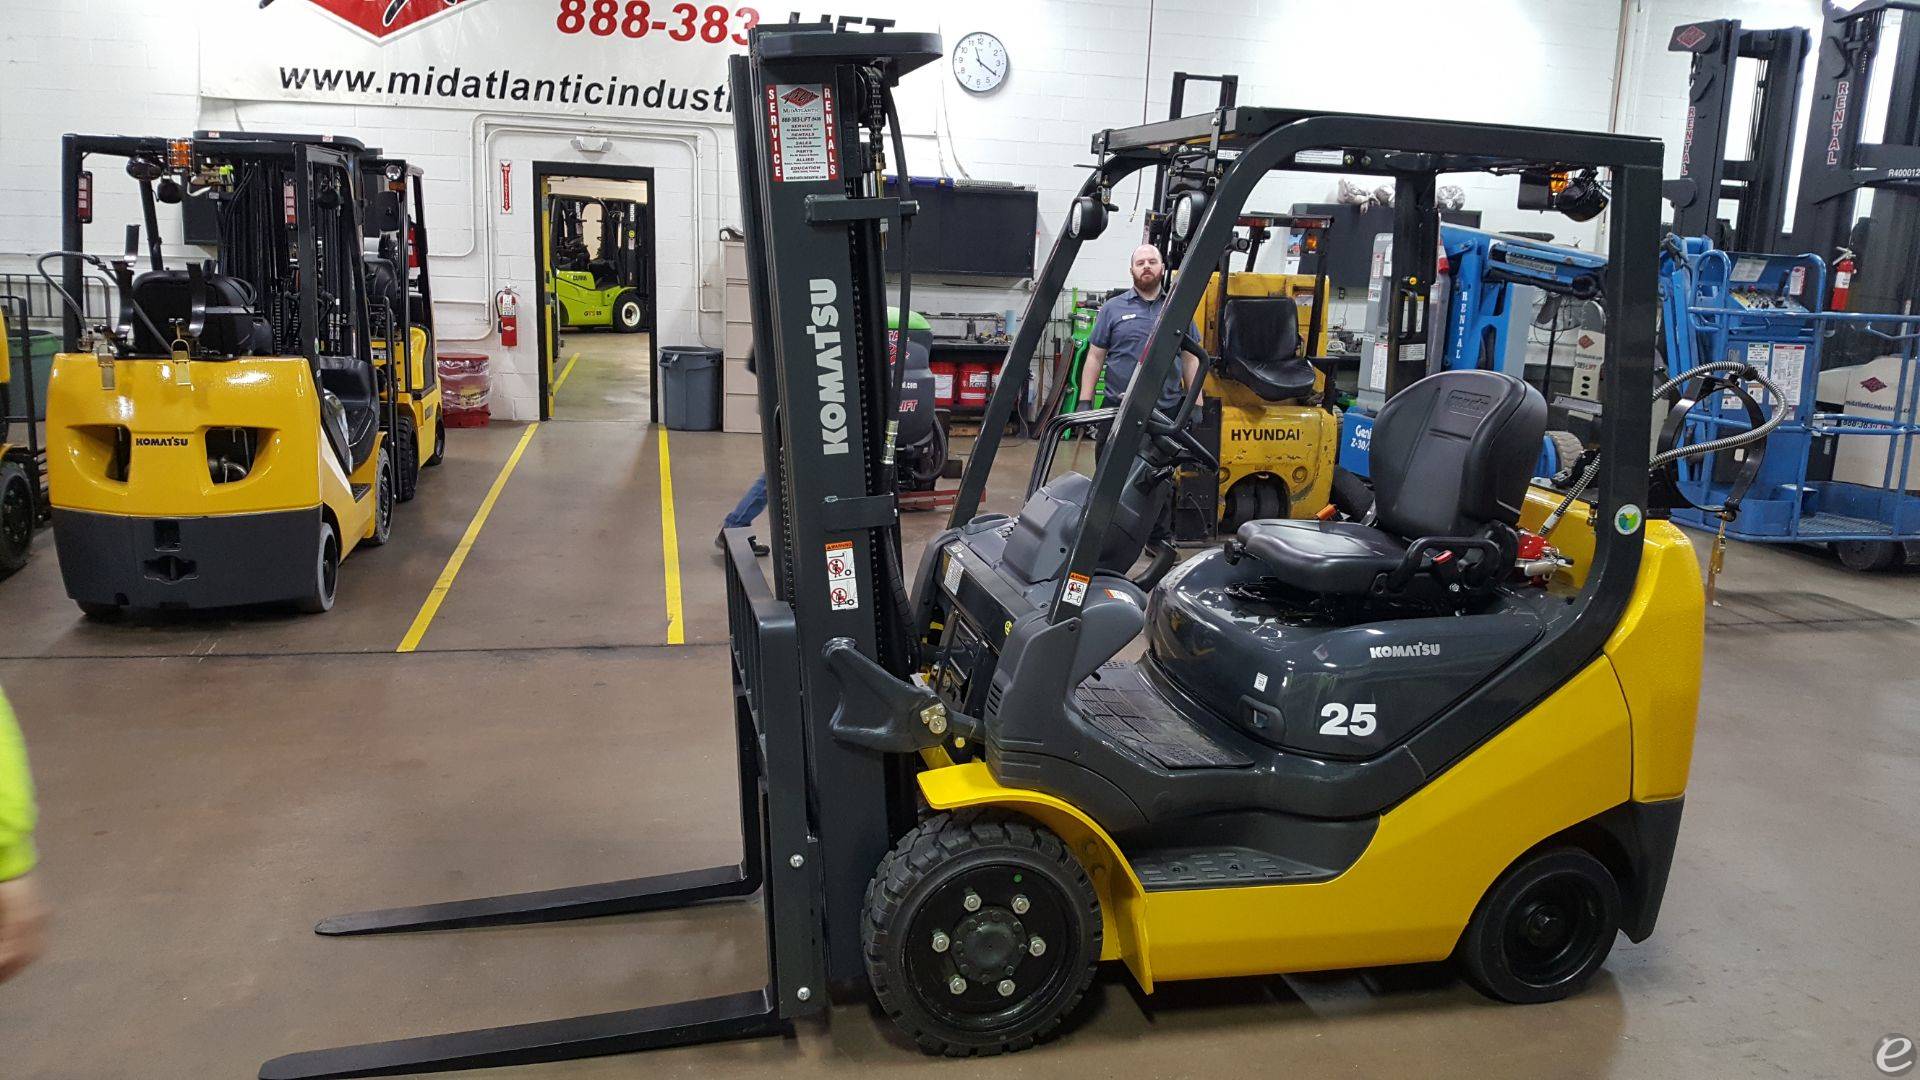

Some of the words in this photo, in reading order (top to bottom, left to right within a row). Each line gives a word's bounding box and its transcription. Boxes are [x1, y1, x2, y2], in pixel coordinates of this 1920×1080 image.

[768, 89, 781, 177] SERVICE
[824, 88, 836, 175] RENTALS
[1681, 105, 1696, 176] RENTAL
[1827, 81, 1849, 165] RENTAL
[1456, 291, 1468, 359] RENTAL
[806, 278, 849, 455] KOMATSU
[136, 436, 189, 446] KOMATSU
[1231, 429, 1300, 441] HYUNDAI
[1369, 641, 1440, 659] KOMATSU
[1319, 702, 1377, 737] 25
